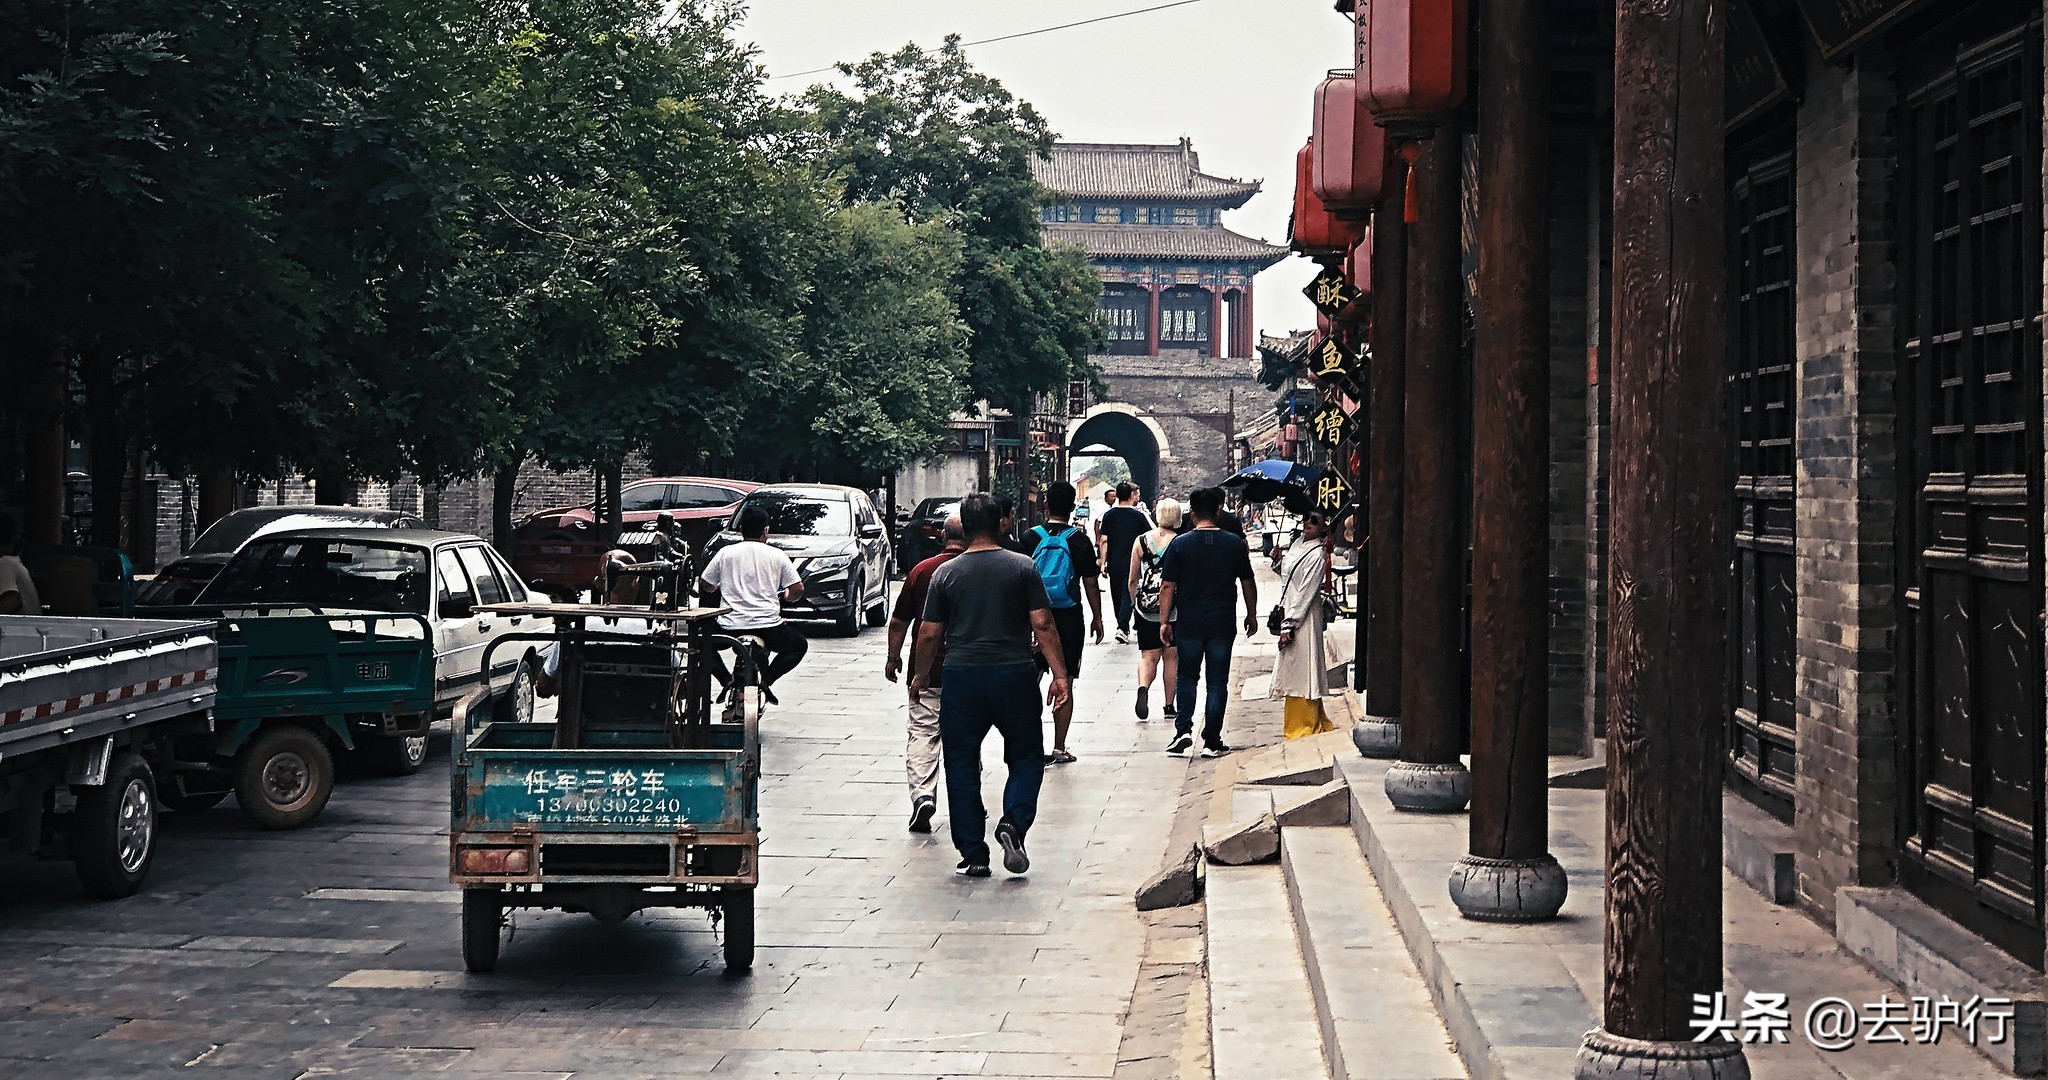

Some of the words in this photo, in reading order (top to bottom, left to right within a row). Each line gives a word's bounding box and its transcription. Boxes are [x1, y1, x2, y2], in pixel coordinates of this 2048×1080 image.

[356, 662, 390, 680] 电动
[523, 768, 666, 797] 任军三轮车
[537, 798, 681, 813] 13700302240
